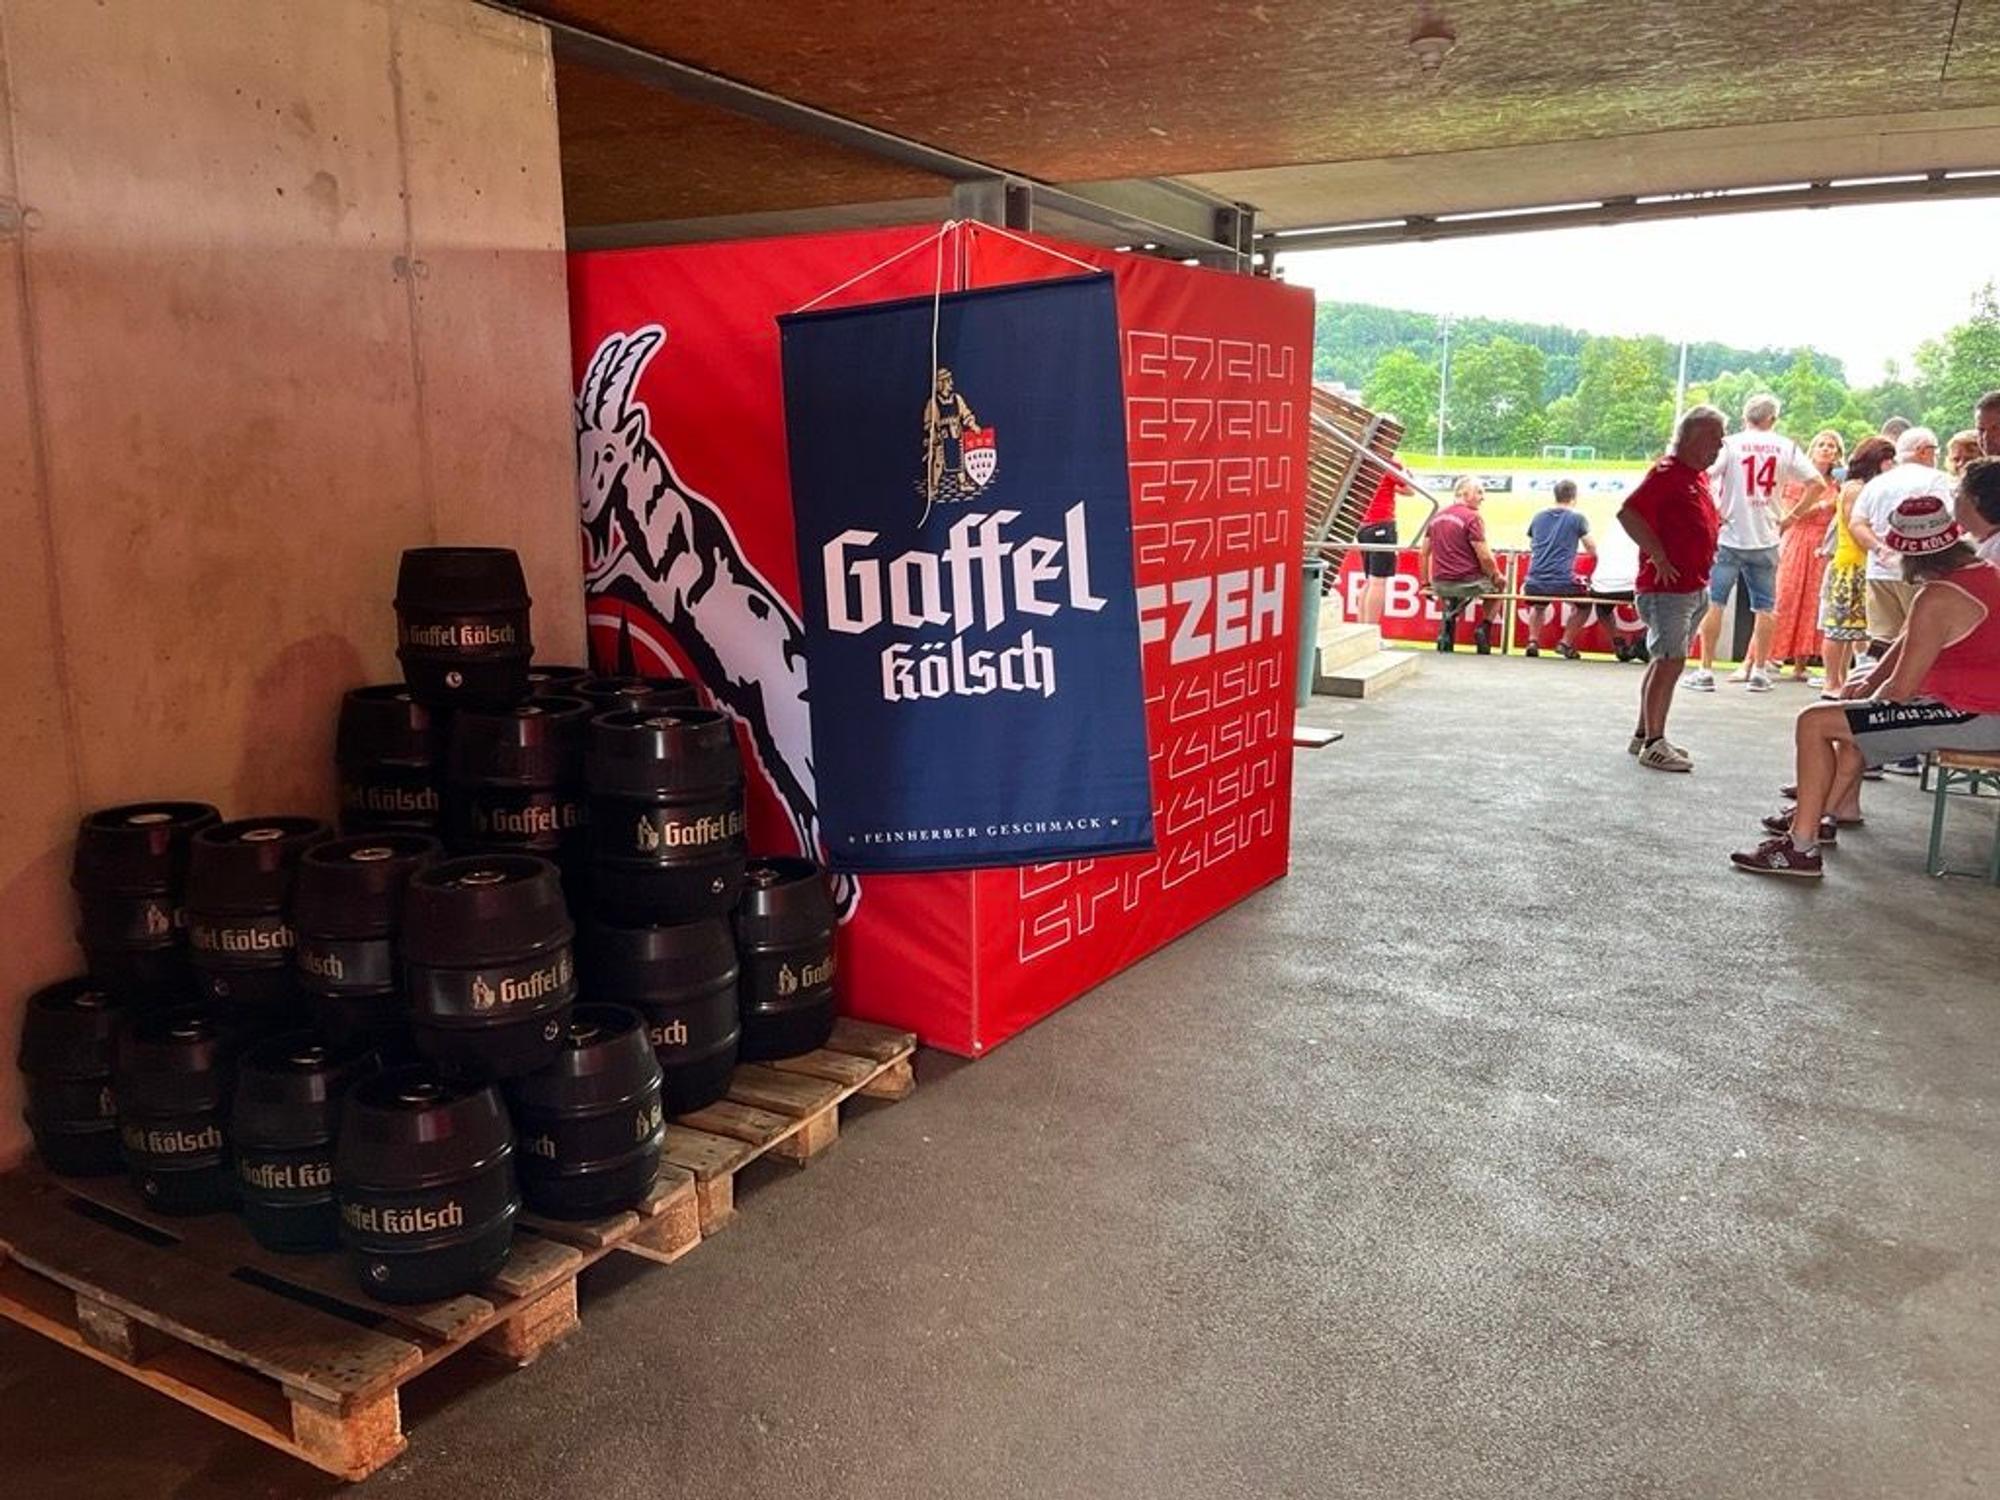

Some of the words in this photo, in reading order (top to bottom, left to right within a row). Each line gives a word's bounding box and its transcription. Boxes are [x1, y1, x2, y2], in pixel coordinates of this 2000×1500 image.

[1741, 455, 1777, 498] 14
[822, 500, 1109, 636] Gaffel
[409, 624, 457, 647] Gaffel
[459, 624, 516, 647] Kölsch
[880, 629, 1056, 702] Kölsch
[367, 785, 440, 813] Kölsch
[493, 805, 558, 835] Gaffel
[664, 813, 727, 848] Gaffel
[864, 825, 978, 845] FEINHERBER
[986, 816, 1102, 837] GESCHMACK
[221, 923, 296, 951] Kölsch
[499, 964, 558, 1004] Gaffel
[148, 1124, 222, 1154] Kölsch
[382, 1200, 463, 1235] Kölsch
